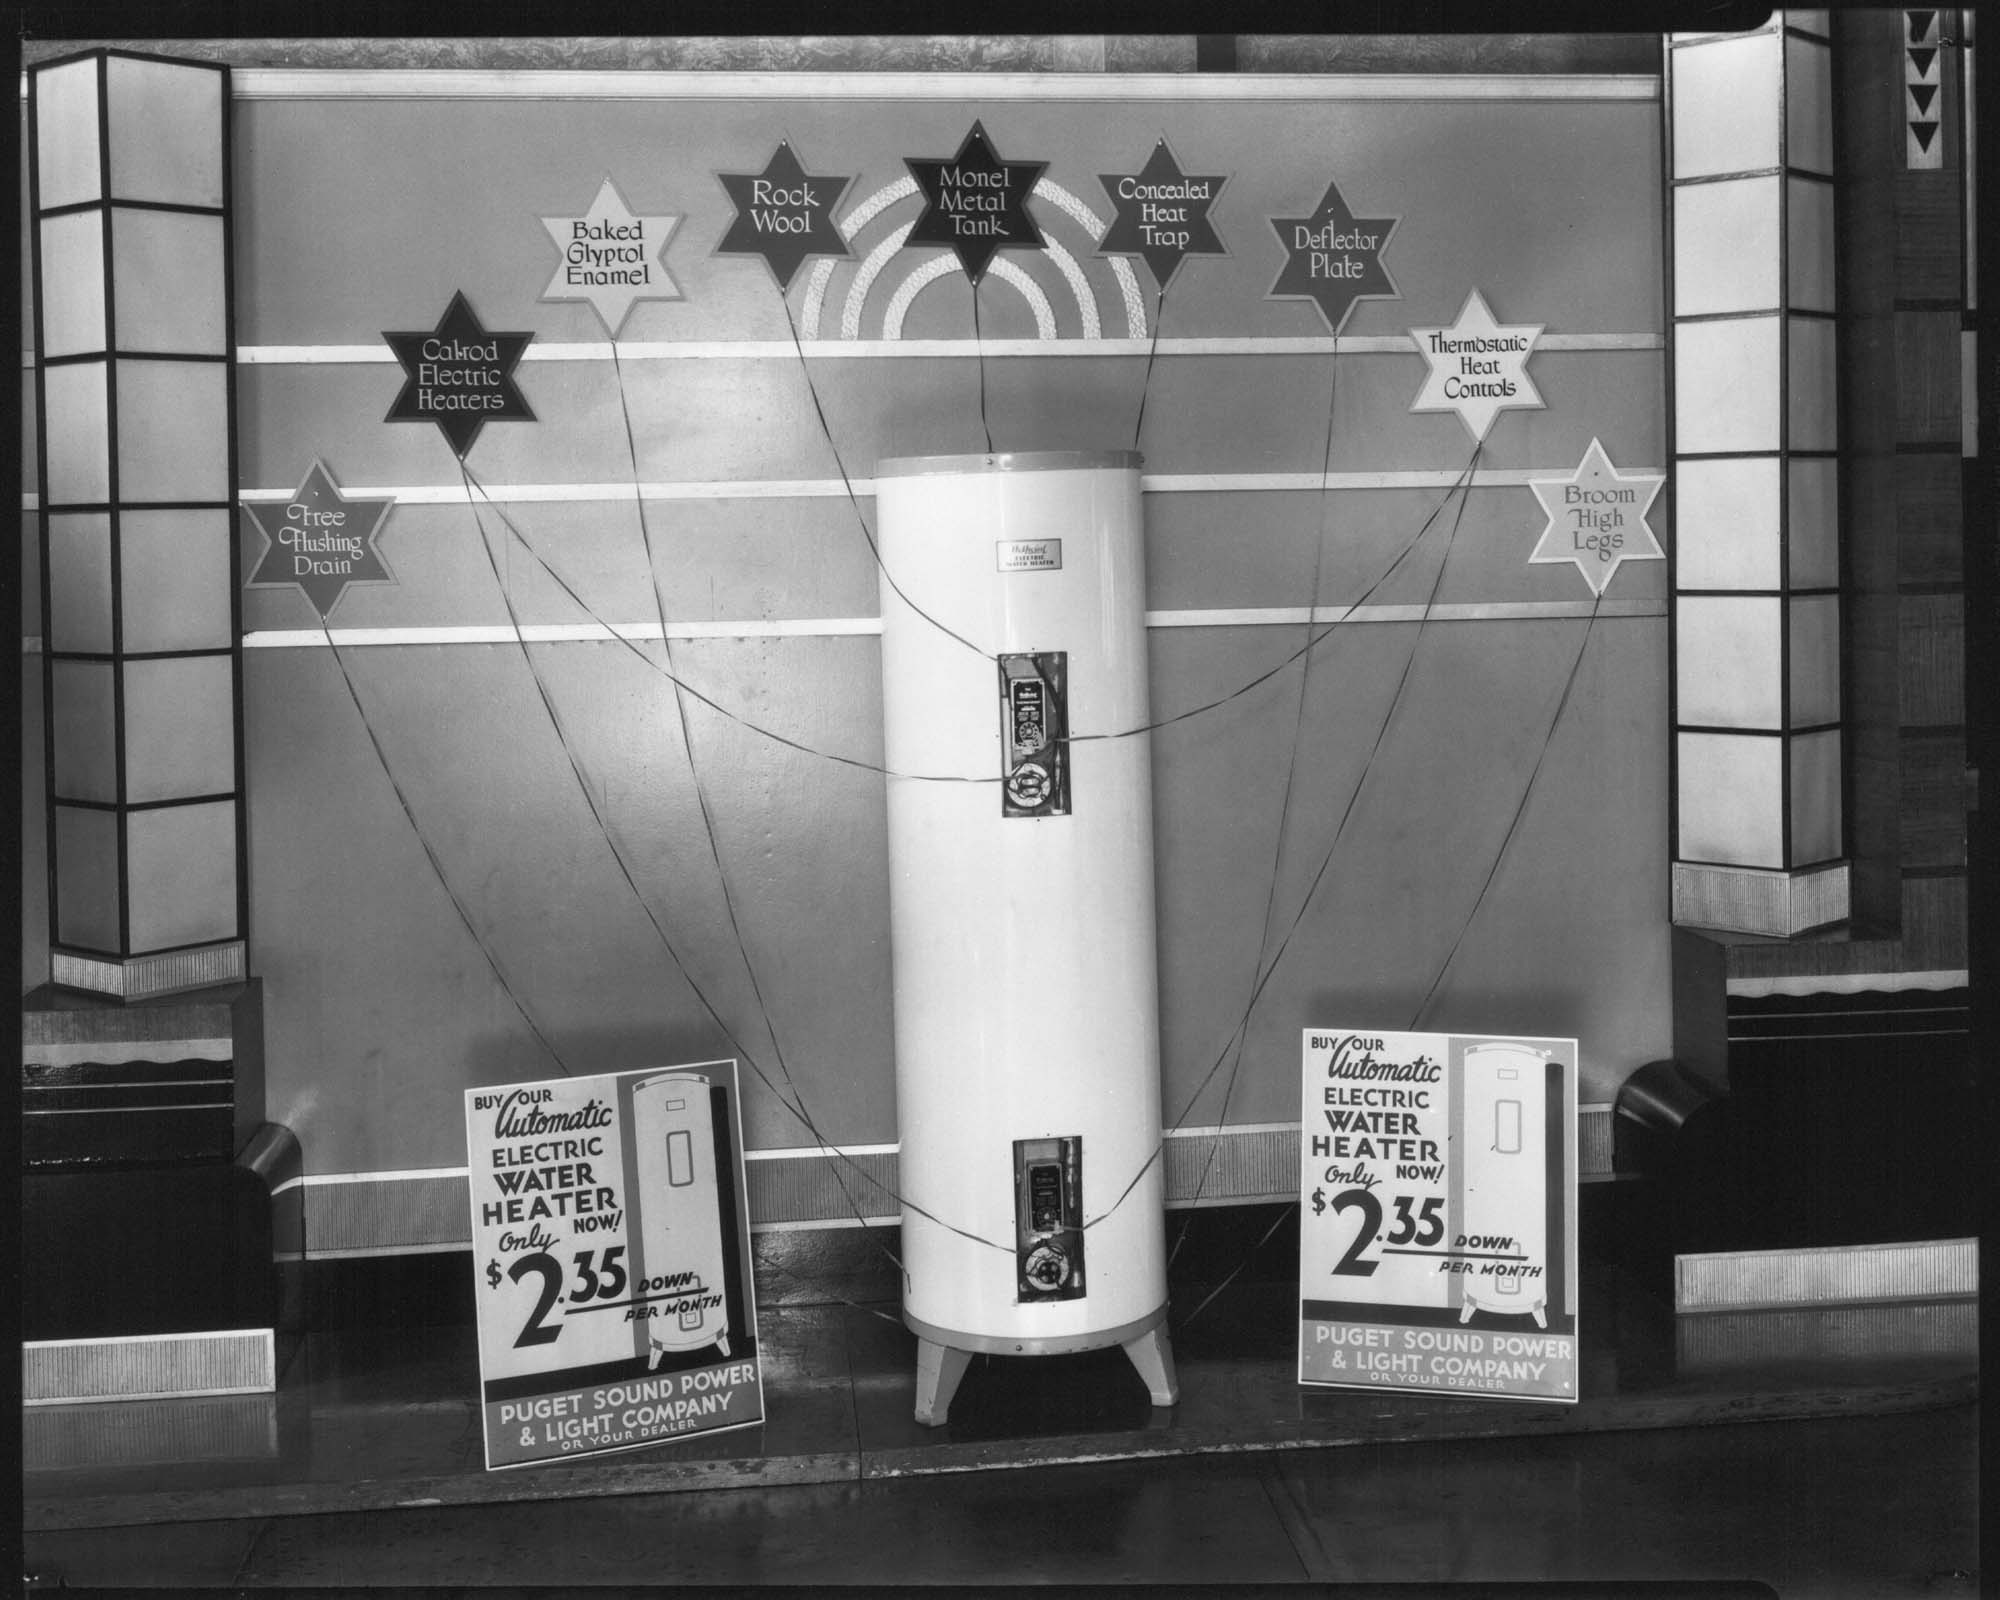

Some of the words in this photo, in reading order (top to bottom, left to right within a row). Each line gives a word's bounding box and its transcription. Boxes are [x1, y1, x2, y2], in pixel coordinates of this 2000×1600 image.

[939, 166, 1011, 188] Monel
[1118, 178, 1210, 201] Concealed
[752, 180, 821, 207] Rock
[939, 189, 1008, 212] Metal
[751, 209, 813, 234] Wool
[949, 214, 1010, 236] Tank
[1141, 203, 1188, 223] Heat
[572, 219, 644, 241] Baked
[1139, 225, 1190, 250] Trap
[1295, 221, 1378, 251] Deflector
[567, 242, 644, 267] Glyptol
[1310, 253, 1364, 279] Plate
[567, 264, 650, 286] Enamel
[422, 338, 500, 362] Calrod
[1428, 332, 1528, 353] Thermostatic
[418, 364, 501, 386] Electric
[1460, 357, 1501, 375] Heat
[417, 388, 505, 411] Heaters
[1444, 377, 1517, 399] Controls
[1565, 485, 1635, 504] Broom
[286, 503, 346, 528] Free
[1567, 508, 1624, 533] High
[278, 526, 363, 559] Flushing
[1573, 531, 1624, 562] Legs
[293, 555, 353, 576] Drain
[1311, 1037, 1338, 1050] BUY
[1351, 1038, 1385, 1051] OUR
[1328, 1035, 1441, 1083] Automatic
[474, 1095, 504, 1111] BUY
[518, 1089, 553, 1105] OUR
[1324, 1087, 1431, 1109] ELECTRIC
[495, 1089, 612, 1140] Automatic
[1324, 1110, 1421, 1136] WATER
[492, 1136, 604, 1169] ELECTRIC
[1312, 1135, 1440, 1162] HEATER
[493, 1162, 597, 1196] WATER
[1324, 1162, 1382, 1189] Only
[1396, 1164, 1445, 1184] NOW!
[482, 1186, 618, 1227] HEATER
[498, 1223, 560, 1255] Only
[573, 1210, 623, 1234] NOW!
[1454, 1234, 1513, 1250] DOWN
[638, 1272, 694, 1292] DOWN
[1439, 1261, 1474, 1275] PER
[1481, 1262, 1543, 1278] MONTH
[624, 1305, 659, 1322] PER
[665, 1294, 723, 1316] MONTH
[1316, 1325, 1395, 1348] PUGET
[1404, 1331, 1484, 1353] SOUND
[1493, 1336, 1571, 1360] POWER
[1332, 1351, 1347, 1369] &
[1356, 1351, 1423, 1373] LIGHT
[1431, 1356, 1546, 1381] COMPANY
[1371, 1371, 1391, 1382] OR
[1399, 1374, 1441, 1385] YOUR
[1448, 1376, 1505, 1389] DEALER
[501, 1394, 583, 1425] PUGET
[593, 1378, 673, 1410] SOUND
[681, 1364, 756, 1393] POWER
[519, 1426, 535, 1447] &
[546, 1413, 614, 1443] LIGHT
[622, 1391, 733, 1429] COMPANY
[561, 1437, 583, 1451] OR
[589, 1430, 634, 1446] YOUR
[641, 1418, 697, 1437] DEALER
